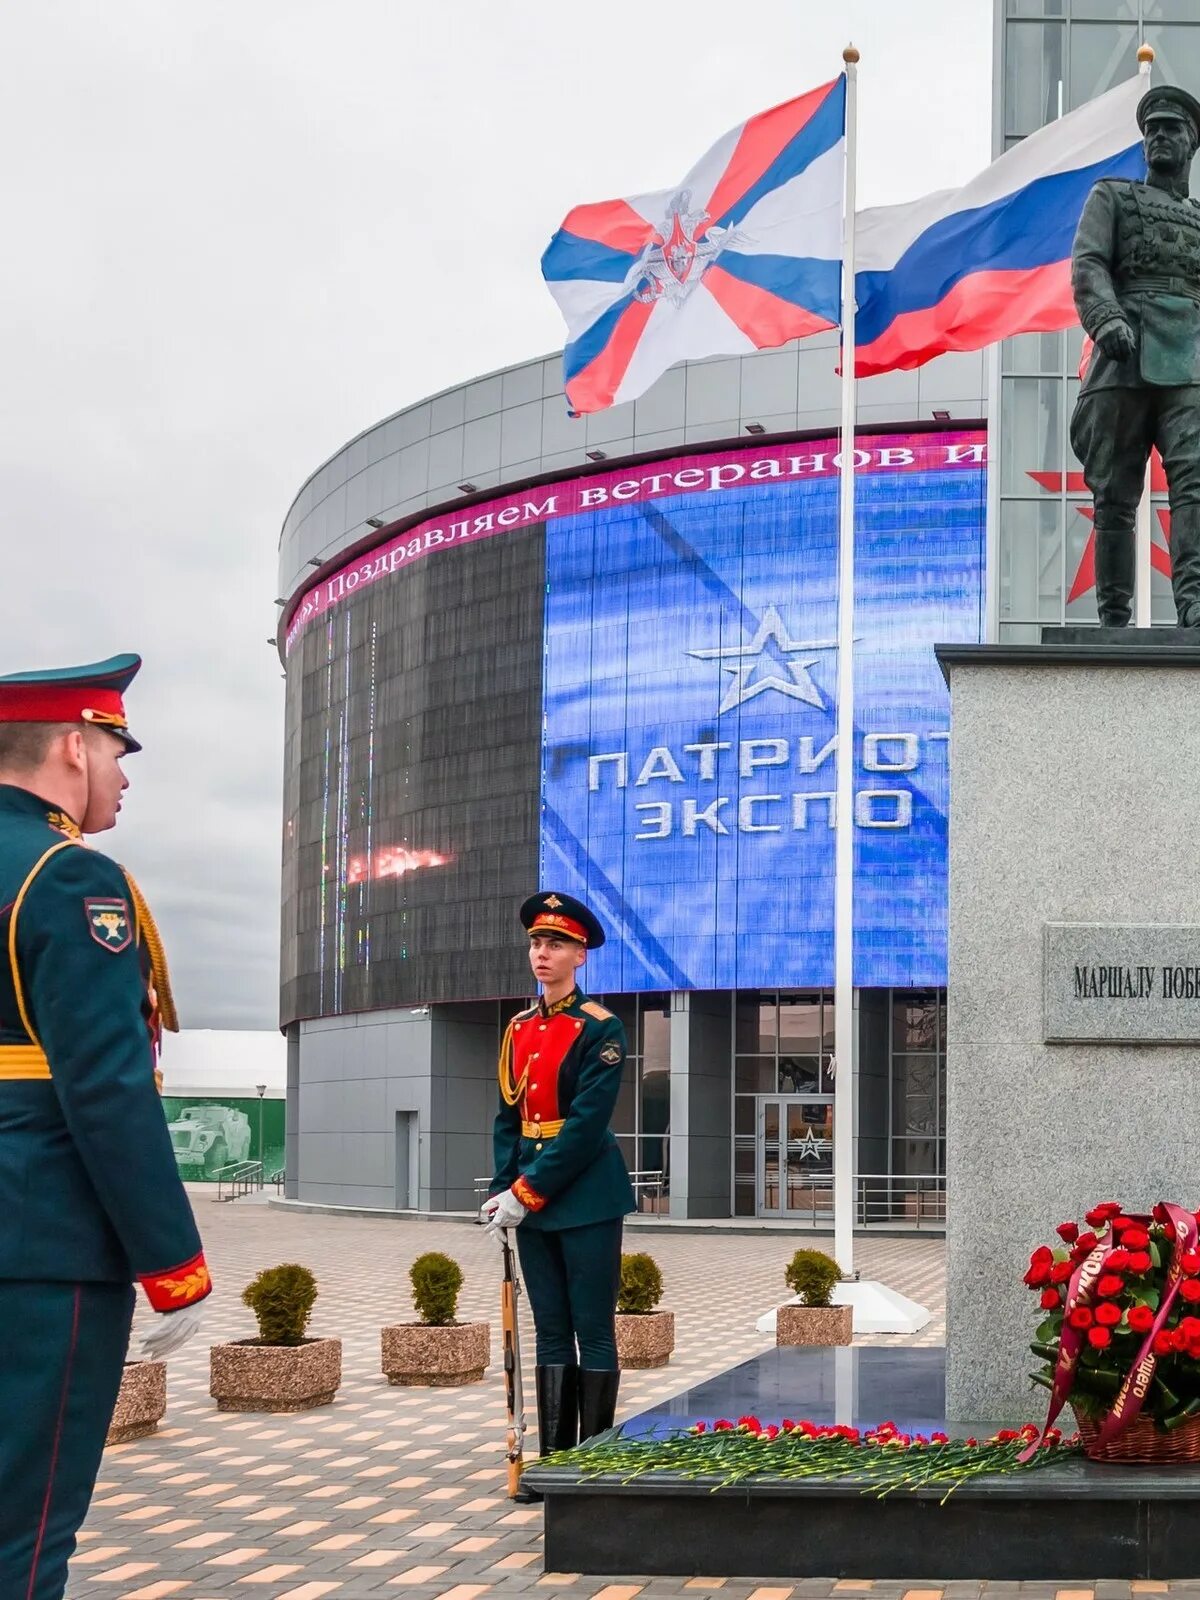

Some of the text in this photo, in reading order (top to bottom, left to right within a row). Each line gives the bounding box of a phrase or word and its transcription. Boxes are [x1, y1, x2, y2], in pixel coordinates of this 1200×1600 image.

[327, 495, 559, 602] Поздравляем
[580, 447, 915, 507] ветеранов
[634, 789, 914, 841] ЭКСПО
[1075, 966, 1155, 998] МАРШАЛУ
